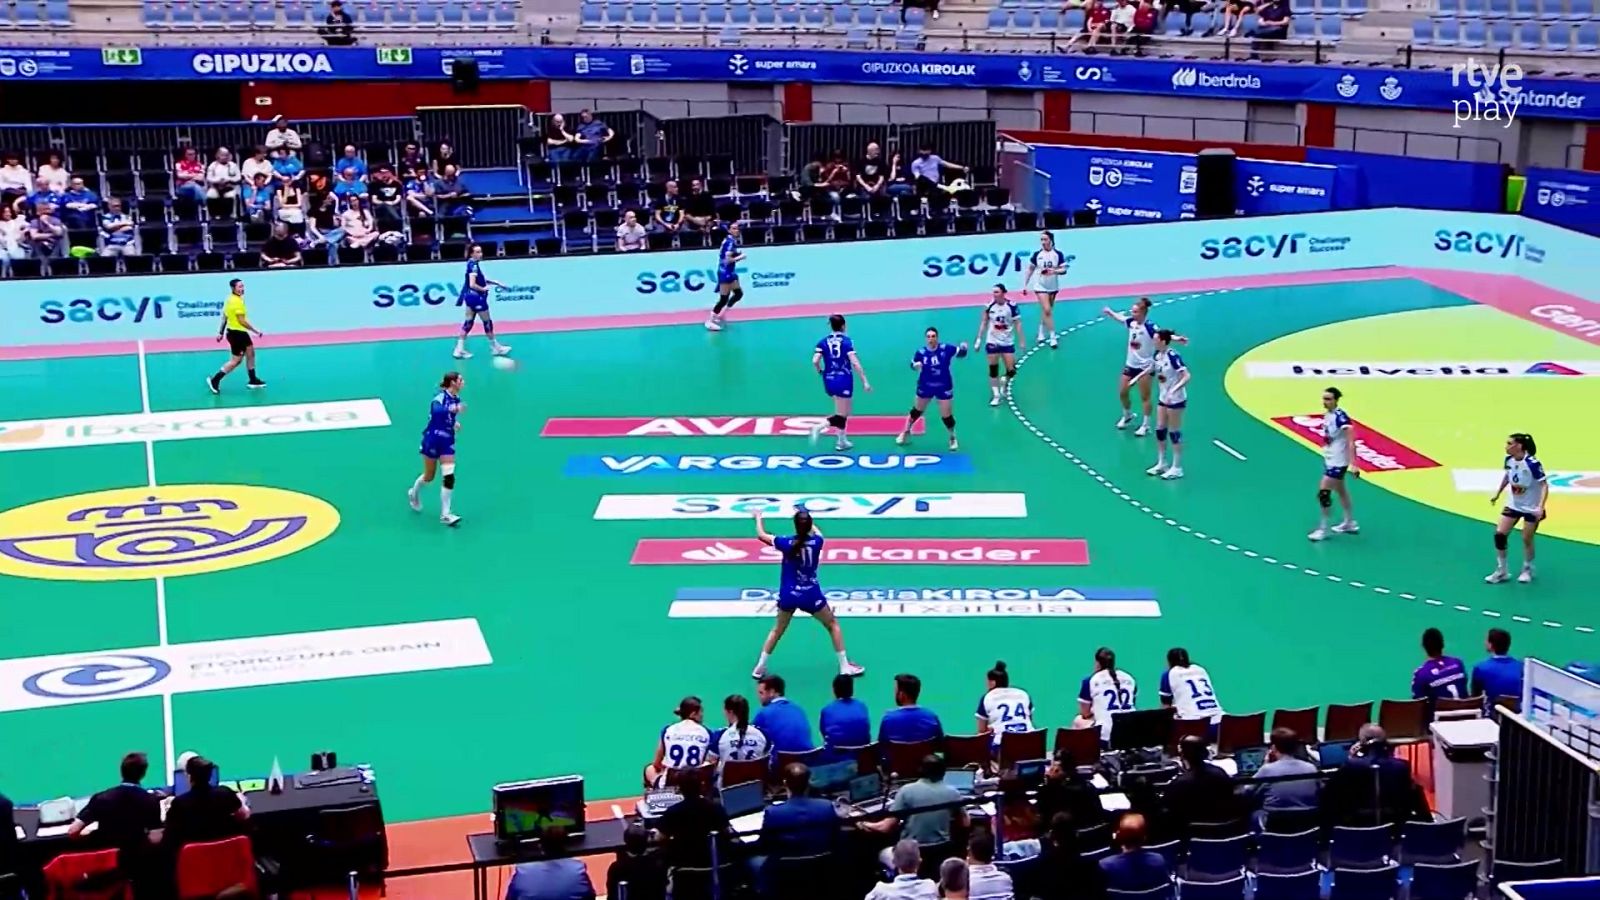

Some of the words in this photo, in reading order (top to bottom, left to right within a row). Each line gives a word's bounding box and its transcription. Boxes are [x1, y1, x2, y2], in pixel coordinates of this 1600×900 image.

[193, 53, 333, 73] GIPUZKOA
[755, 61, 784, 69] super
[862, 62, 920, 74] GIPUZKOA
[921, 64, 976, 75] KIROLAK
[1199, 72, 1261, 88] Iberdrola
[1498, 90, 1586, 109] Santander
[1200, 232, 1307, 260] sacyr
[1434, 230, 1525, 258] sacyr
[922, 250, 1031, 278] sacyr
[751, 272, 796, 281] Challenge
[752, 280, 790, 289] Success
[40, 295, 172, 324] sacyr
[176, 301, 225, 310] Challeng
[828, 341, 841, 358] 13
[1292, 364, 1510, 376] helvetia
[65, 409, 359, 438] Iberdrola
[626, 416, 831, 435] AVIS
[672, 496, 953, 518] sacyr
[758, 546, 1041, 562] Sntander
[1186, 678, 1214, 699] 13
[1103, 688, 1133, 711] 22
[997, 703, 1027, 722] 24
[670, 745, 701, 767] 98
